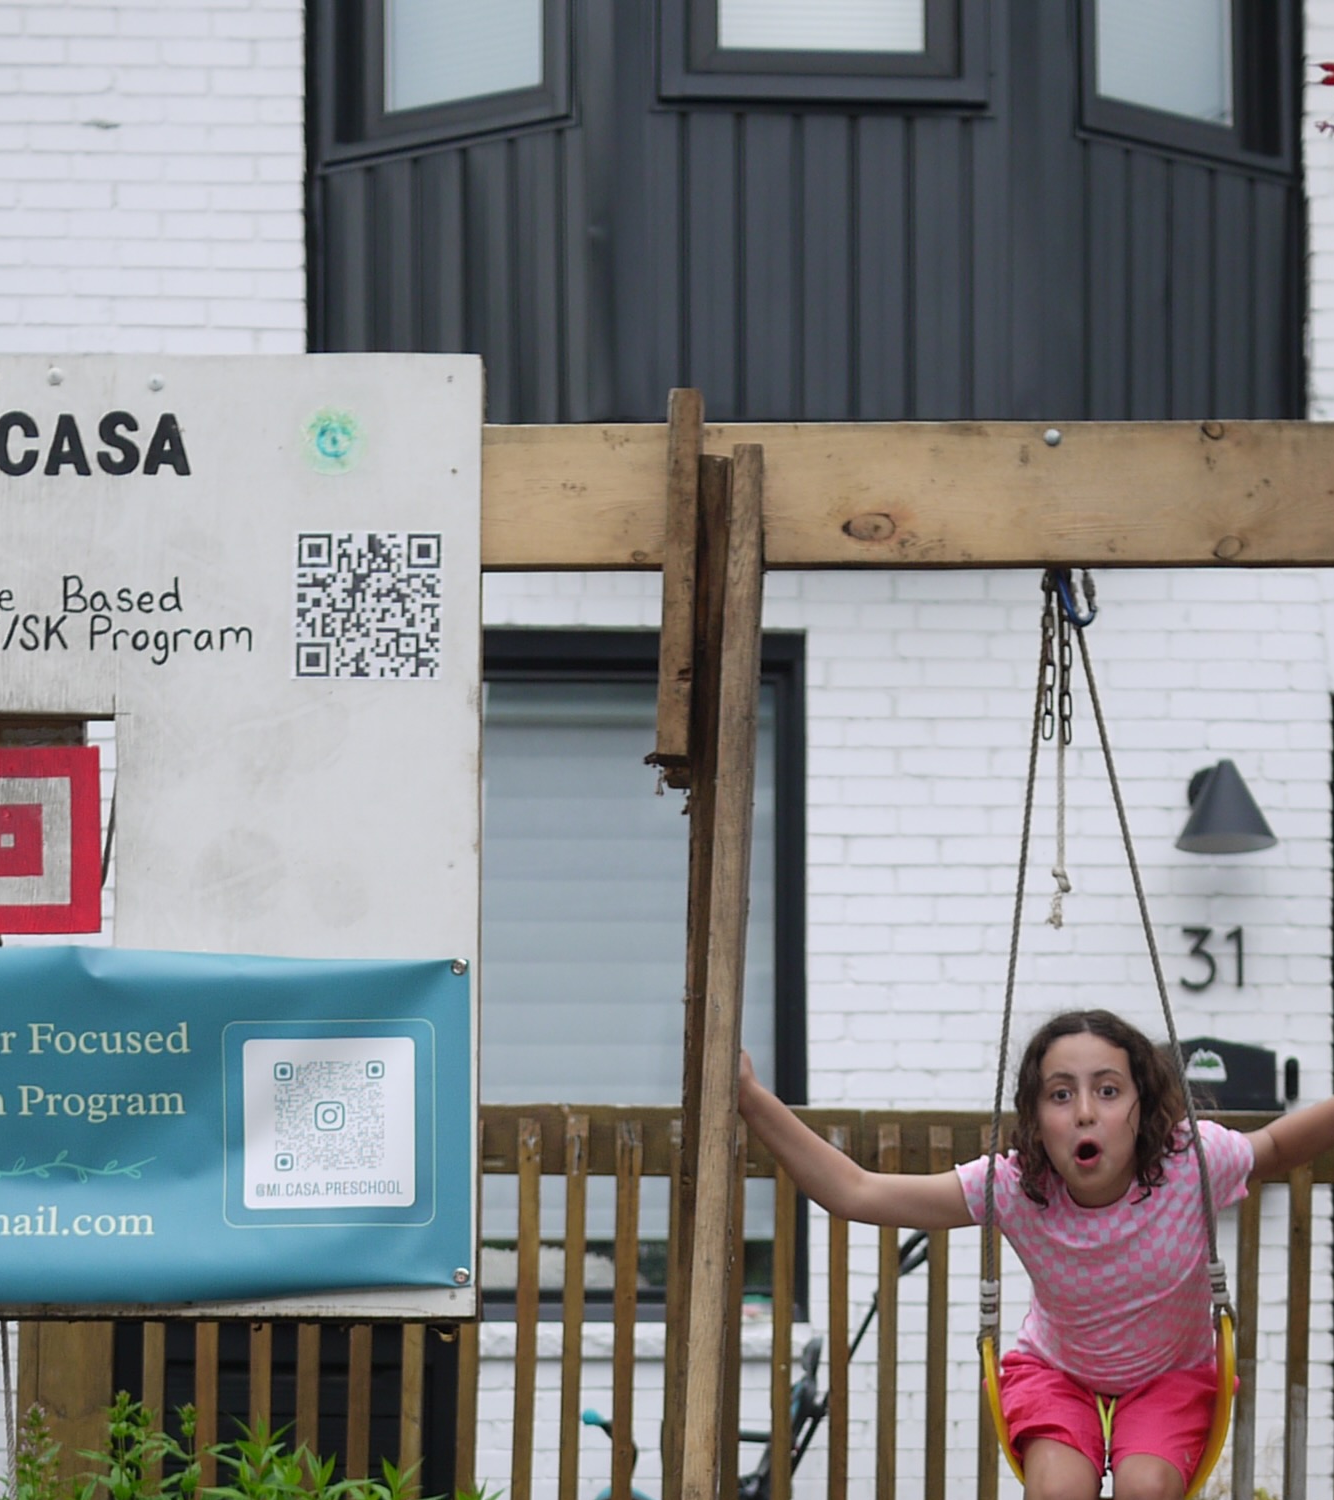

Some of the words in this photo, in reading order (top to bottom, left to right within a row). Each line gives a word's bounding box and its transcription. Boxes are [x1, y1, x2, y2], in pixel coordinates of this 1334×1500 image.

[61, 575, 182, 614] Based
[88, 619, 254, 666] Program
[1180, 926, 1244, 993] 31
[27, 1022, 191, 1055] Focused
[17, 1085, 187, 1124] Program
[255, 1179, 404, 1198] @MI.CASA.PRESCHOOL
